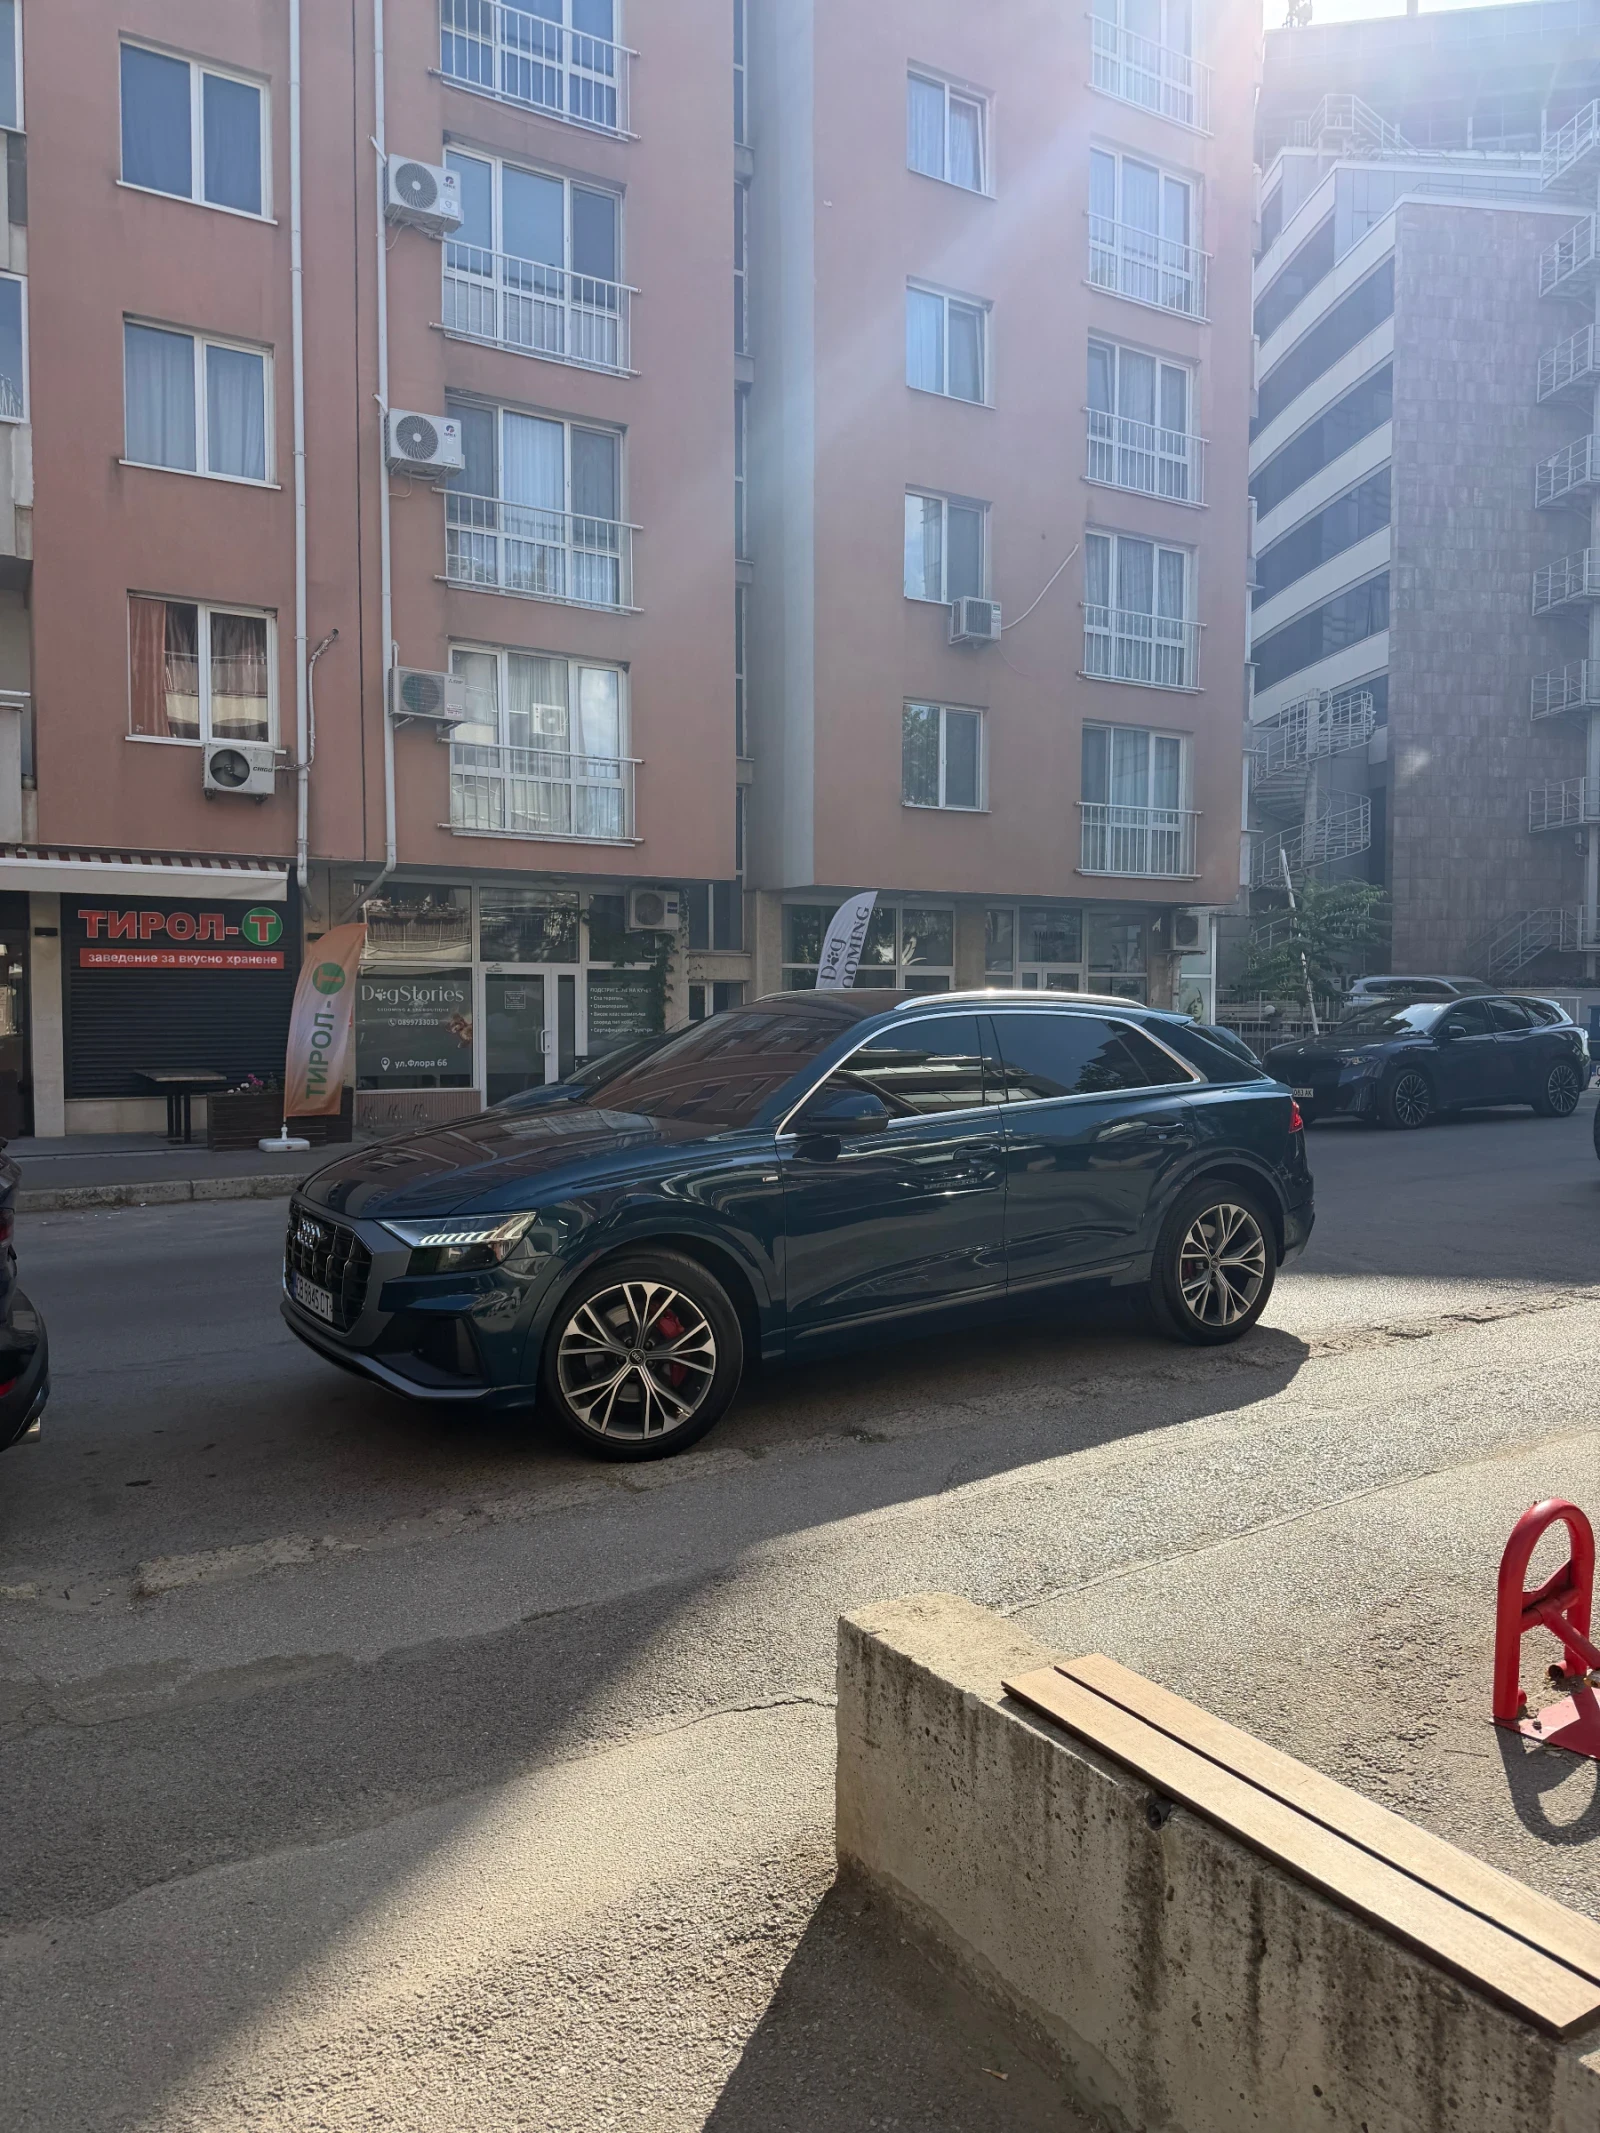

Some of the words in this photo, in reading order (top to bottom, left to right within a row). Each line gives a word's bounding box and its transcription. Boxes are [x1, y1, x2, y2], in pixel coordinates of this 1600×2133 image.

[842, 906, 870, 988] OOMING
[88, 953, 158, 964] заведение
[161, 954, 175, 963] за
[179, 955, 223, 965] вкусно
[226, 955, 278, 966] хранене
[437, 1059, 448, 1067] 66
